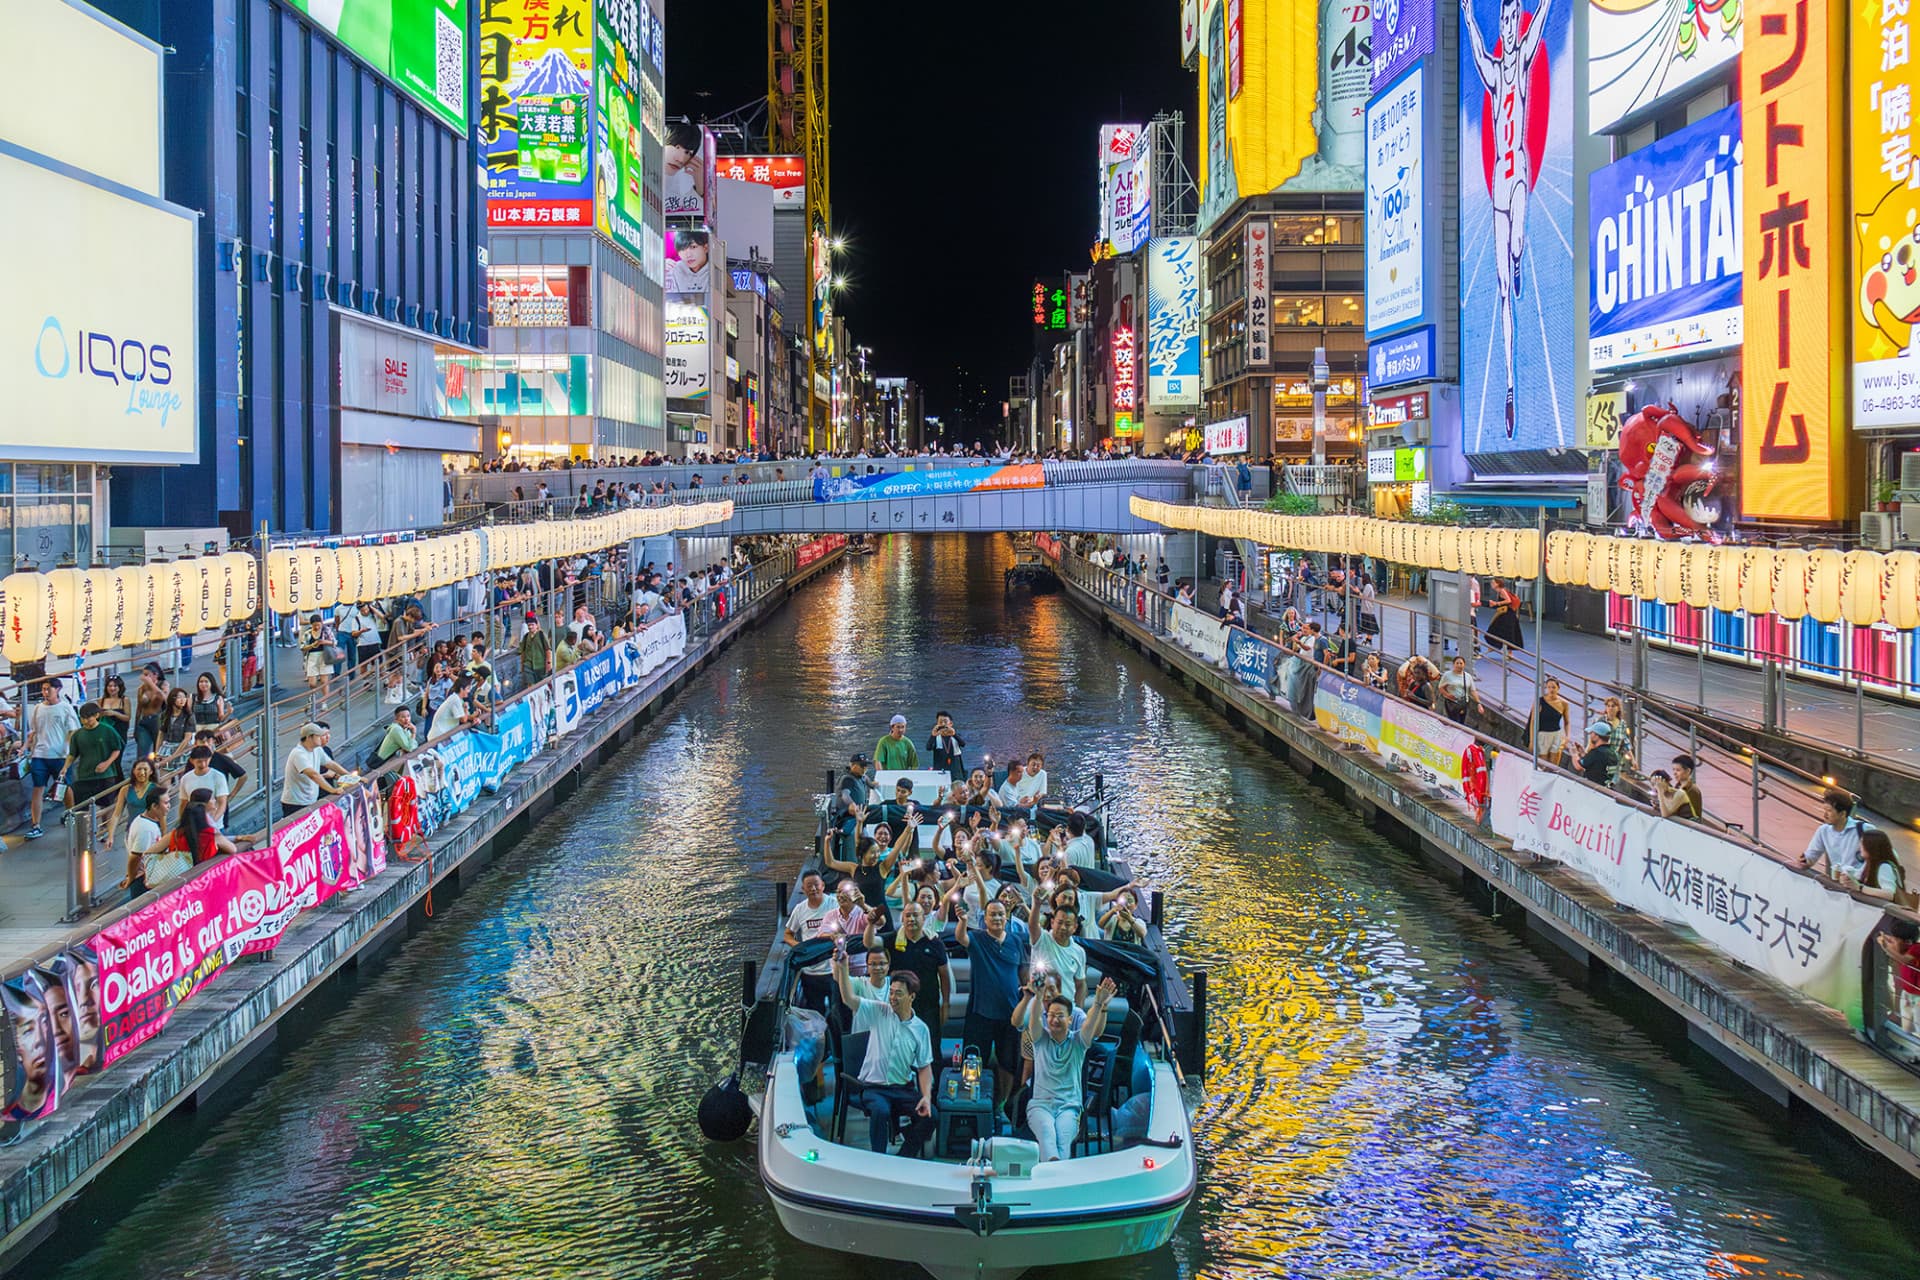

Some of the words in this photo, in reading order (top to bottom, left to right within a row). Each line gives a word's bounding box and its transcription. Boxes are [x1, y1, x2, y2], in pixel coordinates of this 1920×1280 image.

[520, 113, 576, 133] 大麦若葉
[1503, 84, 1516, 180] グリコ
[1378, 126, 1410, 167] ありがとう
[515, 190, 537, 199] Japan
[729, 165, 770, 181] 免税
[492, 208, 580, 223] 山本漢方製薬
[1252, 244, 1265, 291] 本場の味
[1051, 289, 1067, 324] 千房
[79, 330, 172, 386] IQOS
[385, 358, 408, 378] SALE
[1387, 354, 1422, 378] 雪印メグミルク
[125, 371, 182, 428] Lounge
[1732, 389, 1739, 428] 2F
[869, 510, 956, 524] えびす橋
[201, 568, 209, 621] PABLO
[224, 567, 232, 618] PABLO
[247, 560, 256, 610] PABLO
[290, 557, 299, 604] PABLO
[313, 556, 323, 601] PABLO
[1642, 848, 1821, 967] 大阪樟蔭女子大学
[101, 930, 156, 971] Welome
[159, 921, 171, 938] to
[178, 933, 197, 969] is
[199, 914, 223, 953] our
[174, 977, 193, 1001] NO
